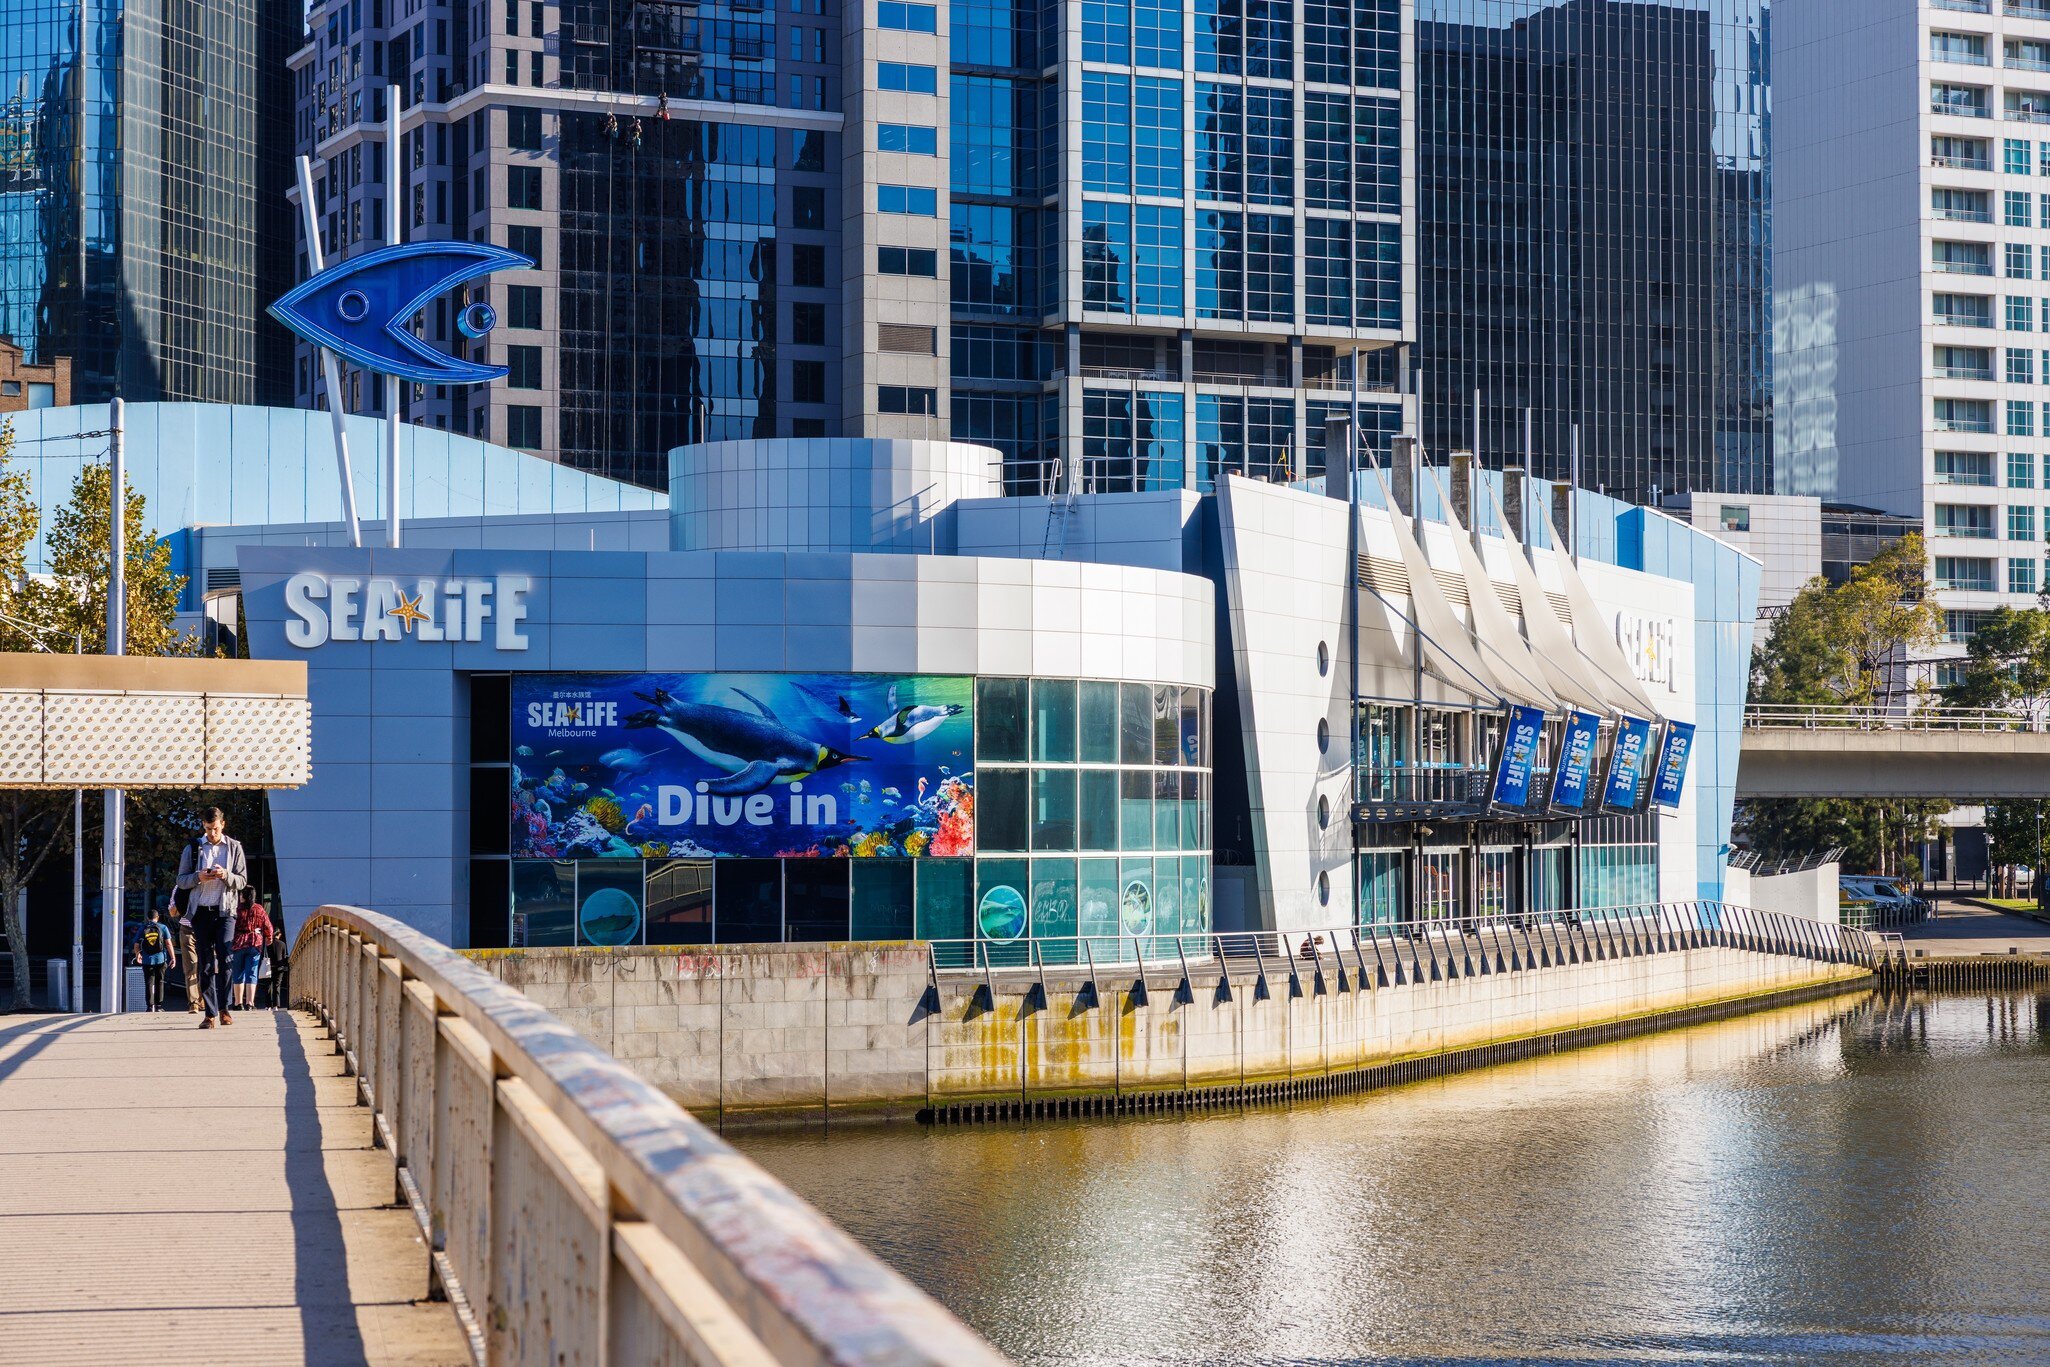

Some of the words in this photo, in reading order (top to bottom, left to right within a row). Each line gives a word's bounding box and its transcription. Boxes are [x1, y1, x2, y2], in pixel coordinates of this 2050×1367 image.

[286, 573, 402, 649] SEA
[528, 702, 569, 727] SEA
[548, 729, 596, 737] Melbourne
[1560, 740, 1572, 773] Melbourne
[658, 781, 774, 826] Dive
[790, 781, 837, 825] in
